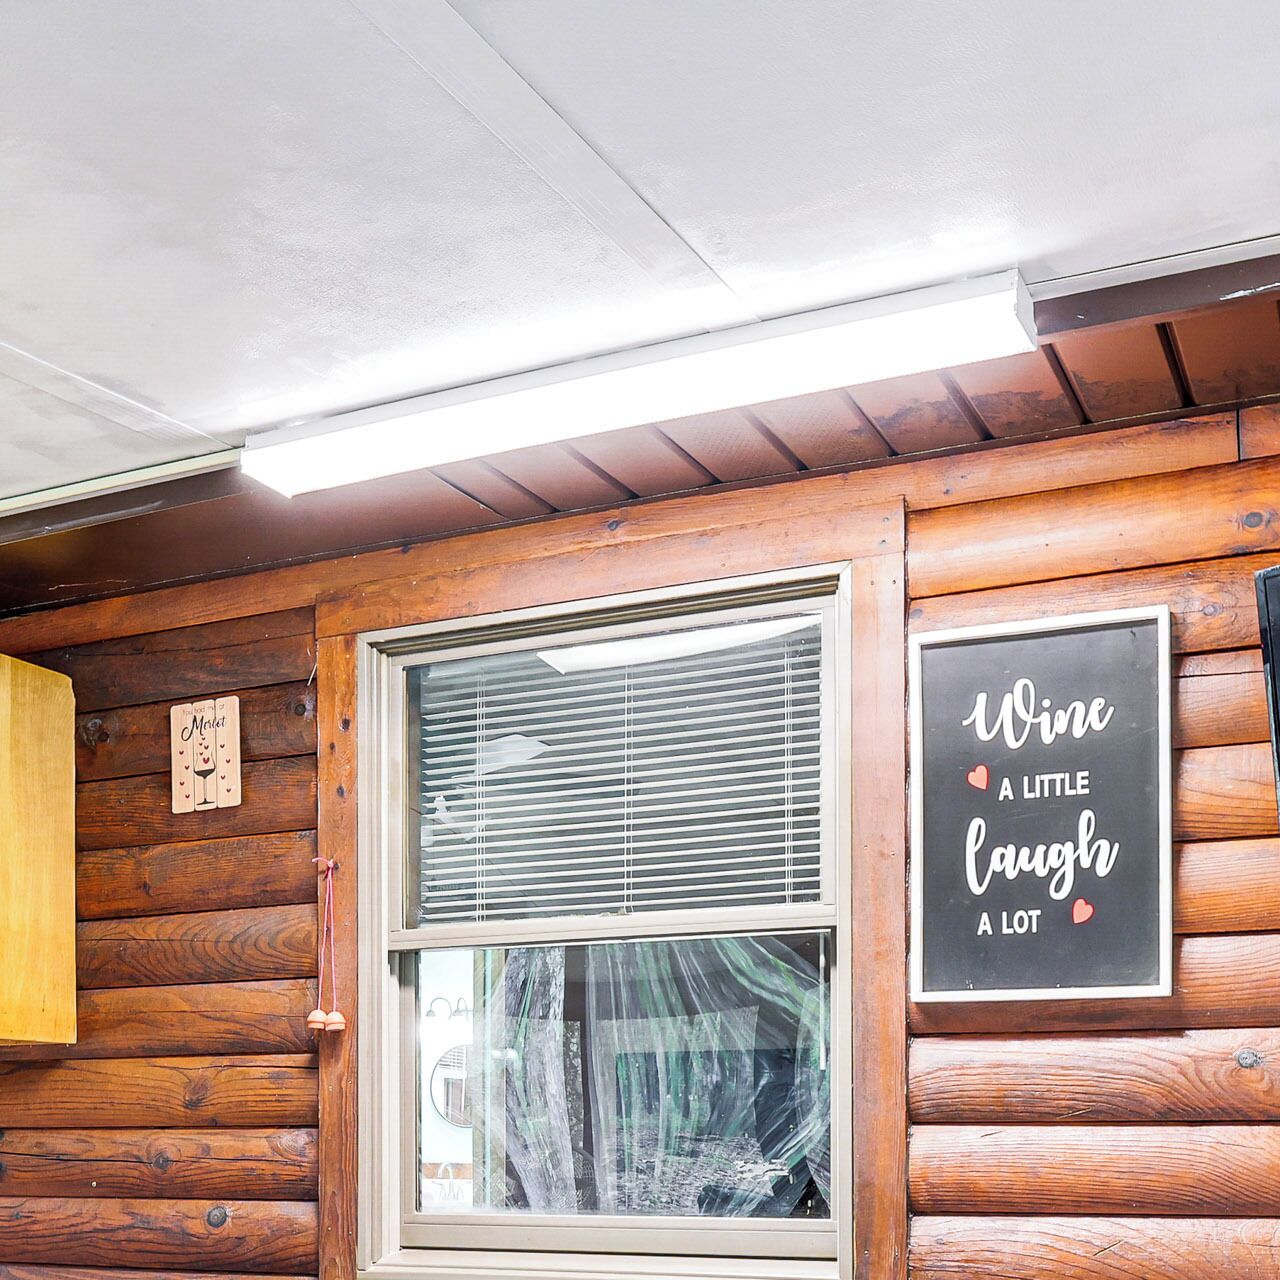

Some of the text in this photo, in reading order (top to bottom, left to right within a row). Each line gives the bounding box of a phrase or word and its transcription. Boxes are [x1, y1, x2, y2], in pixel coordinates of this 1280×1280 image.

[181, 714, 226, 742] Merlot
[962, 678, 1115, 750] Wine
[998, 771, 1090, 801] A LITTLE
[965, 808, 1120, 900] laugh
[977, 910, 1042, 936] A LOT
